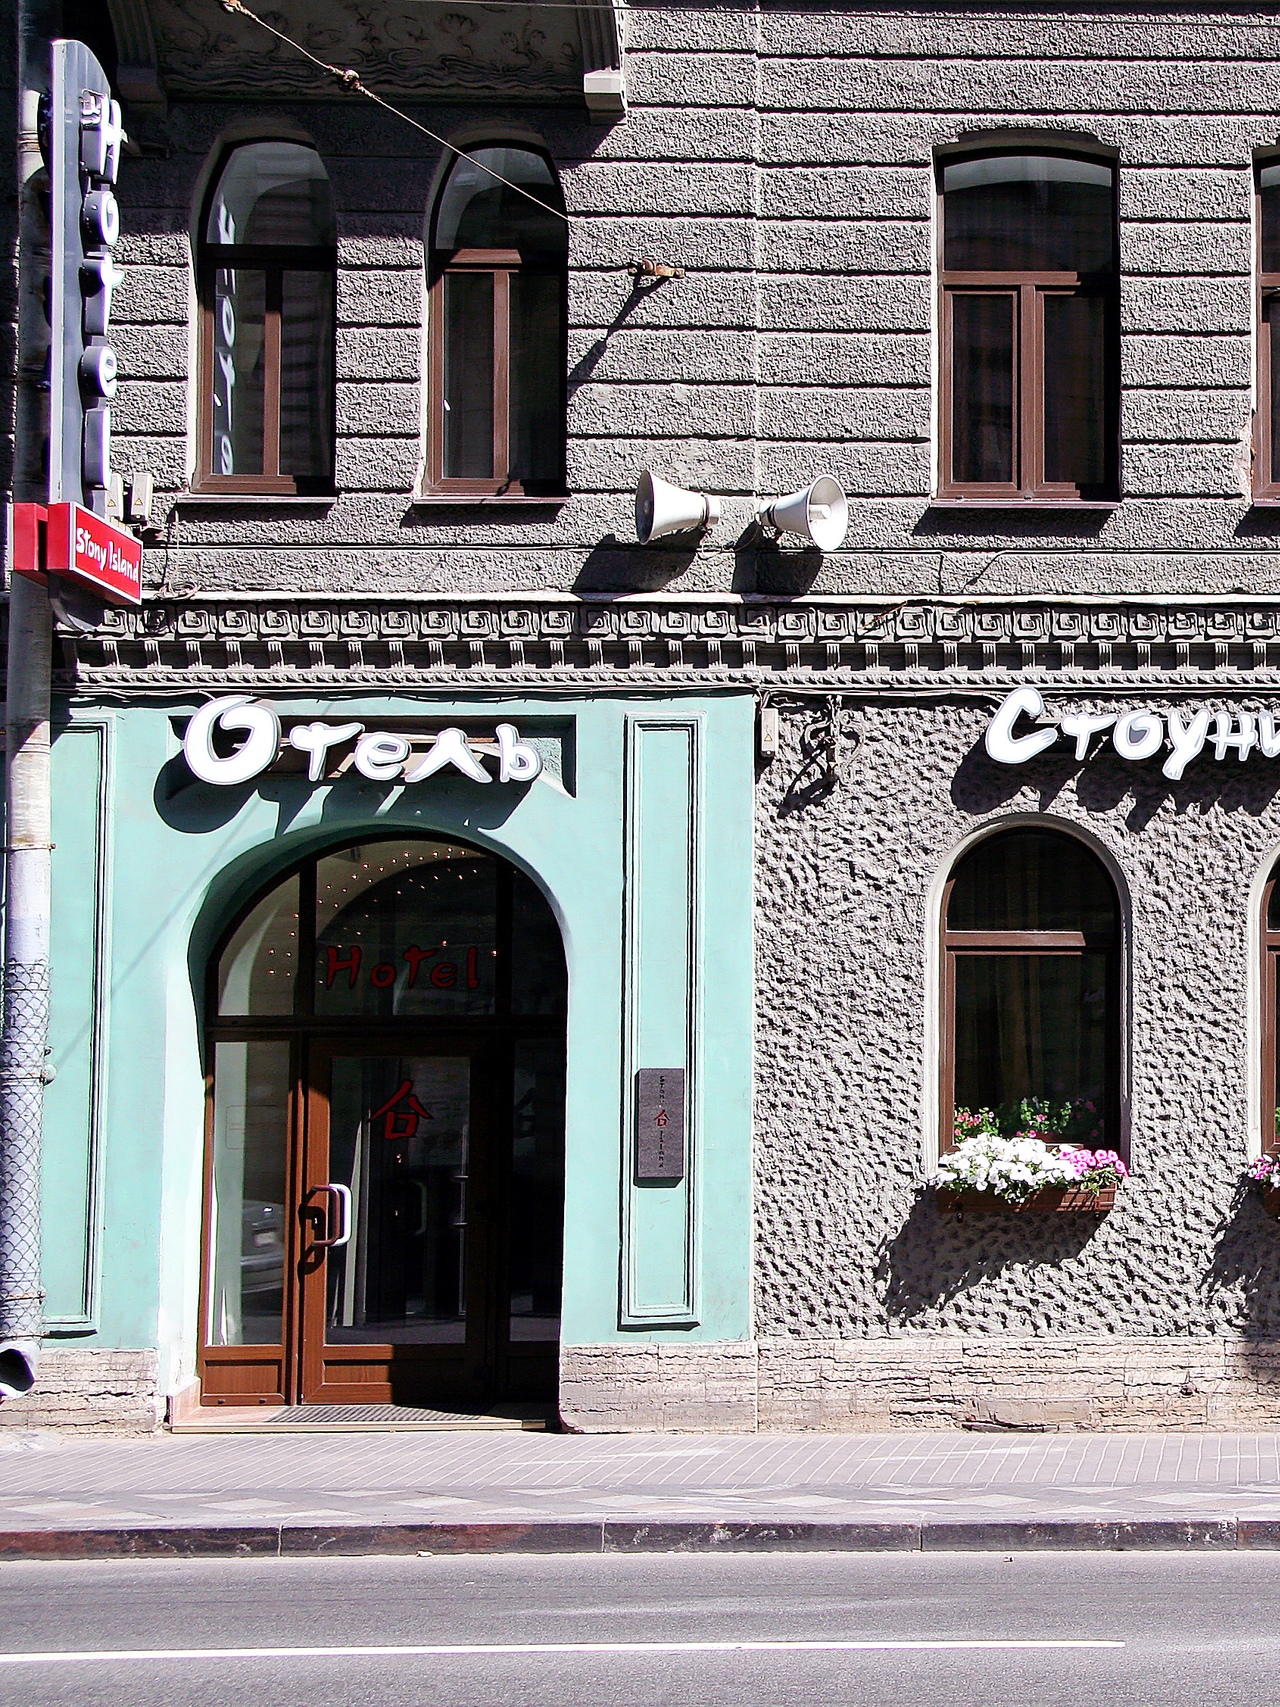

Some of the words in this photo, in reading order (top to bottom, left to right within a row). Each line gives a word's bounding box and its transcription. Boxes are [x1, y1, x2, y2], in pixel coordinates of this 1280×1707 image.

[76, 527, 108, 571] Stony
[109, 541, 139, 584] Island
[184, 695, 544, 785] Отель
[325, 945, 481, 990] Hotel
